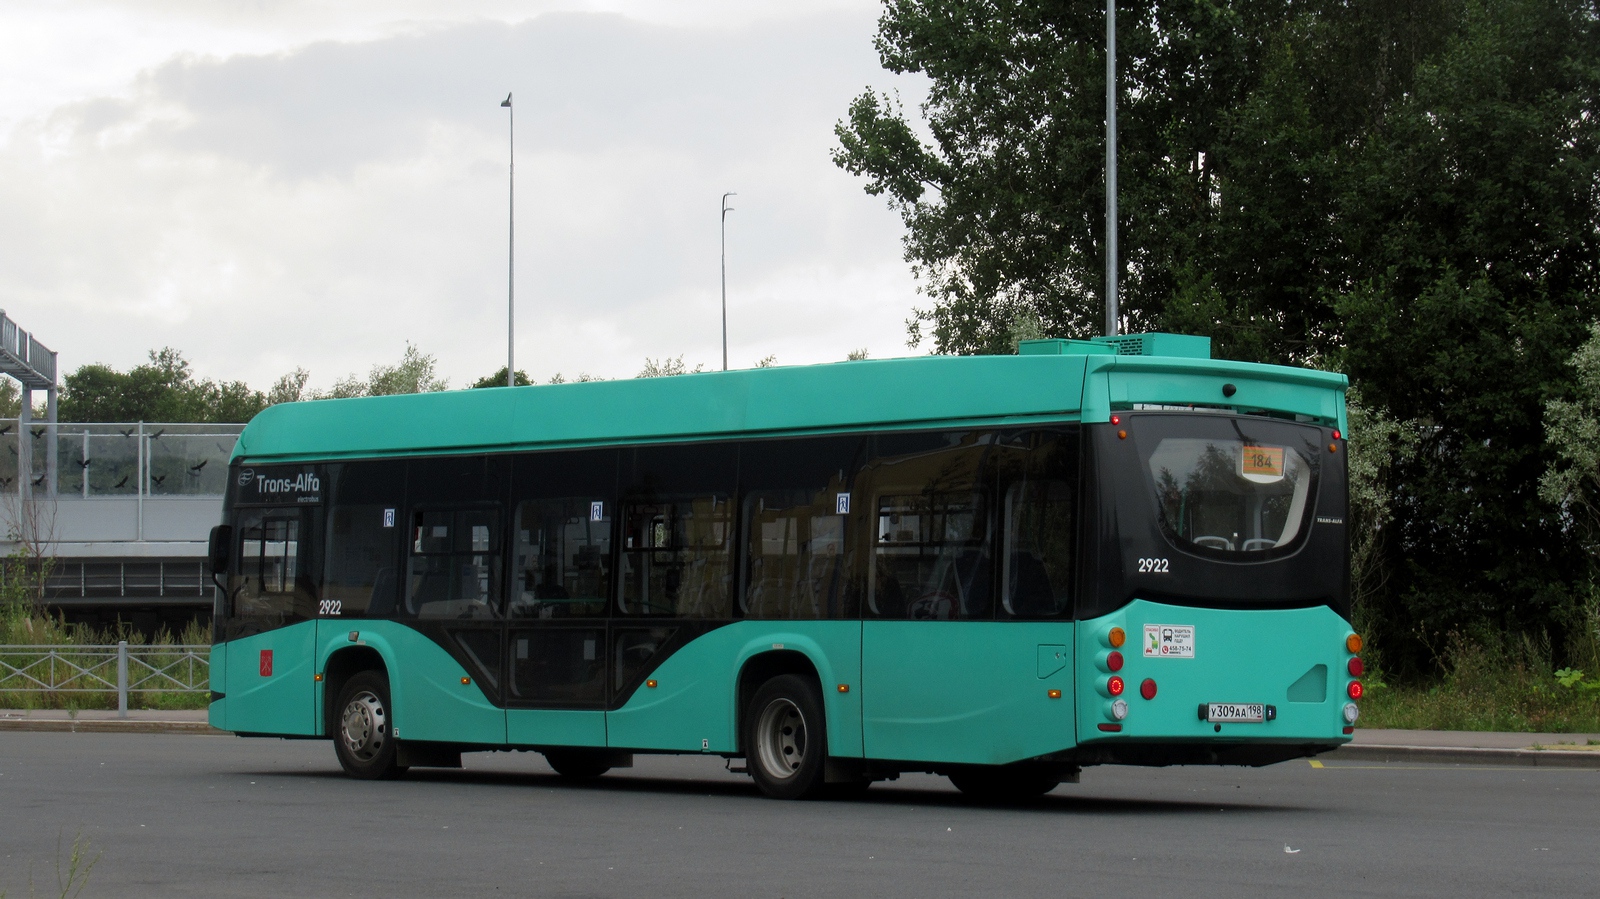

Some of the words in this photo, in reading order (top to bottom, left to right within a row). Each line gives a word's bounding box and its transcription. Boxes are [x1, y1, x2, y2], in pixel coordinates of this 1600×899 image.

[1251, 453, 1273, 468] 184
[256, 472, 321, 494] Trans-Alfa
[1138, 557, 1170, 573] 2922
[318, 599, 342, 615] 2922
[1248, 705, 1262, 715] 198
